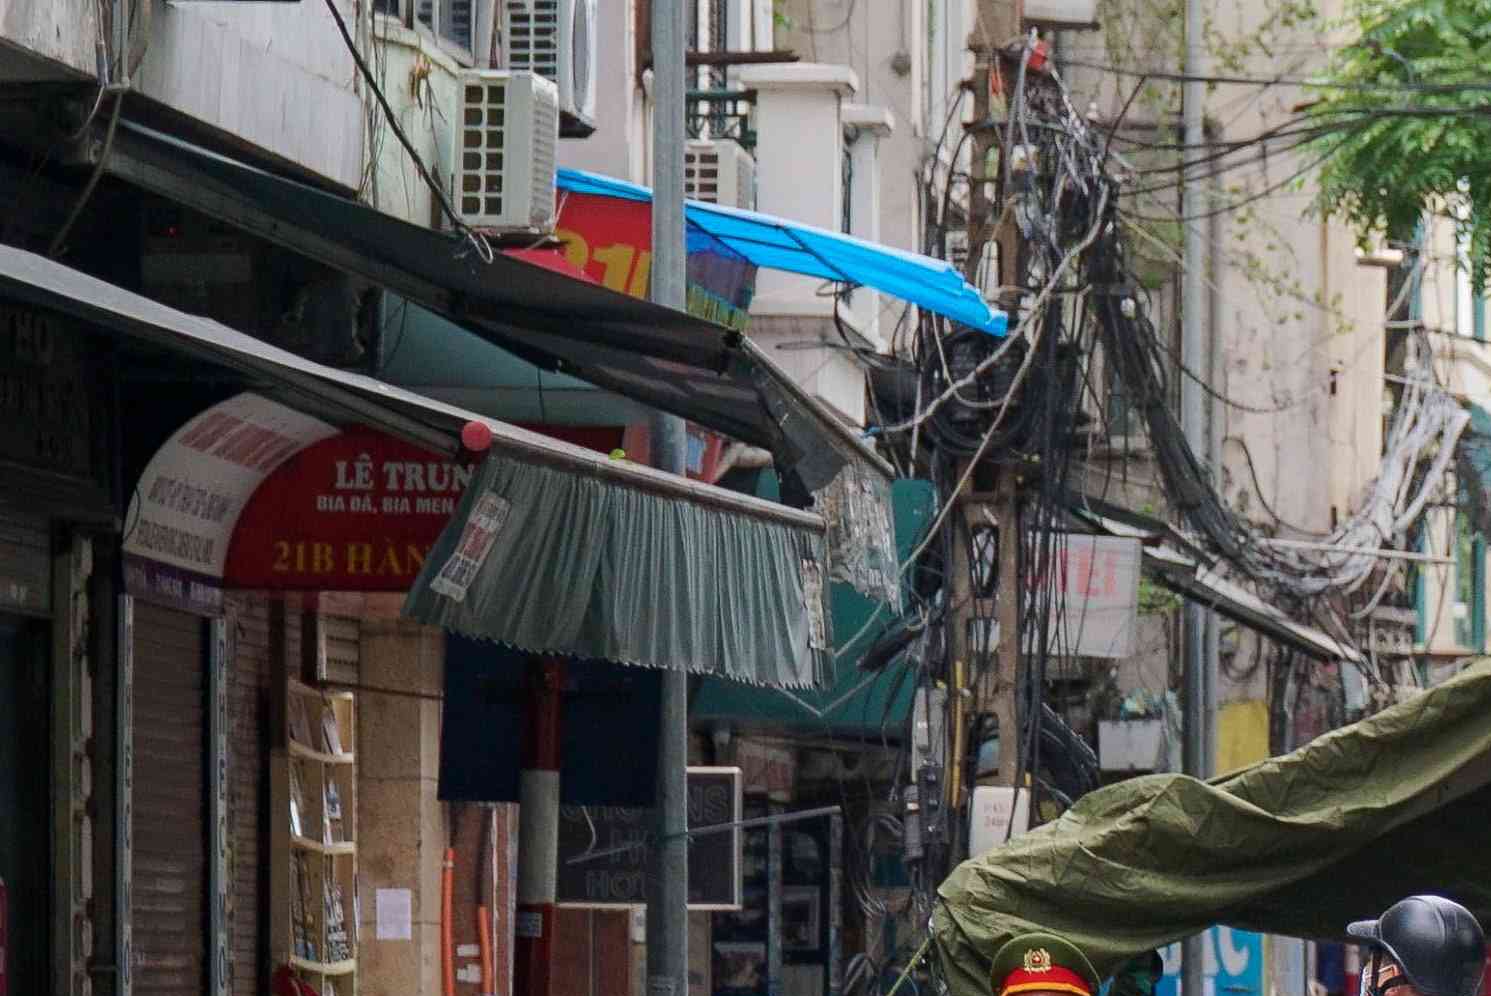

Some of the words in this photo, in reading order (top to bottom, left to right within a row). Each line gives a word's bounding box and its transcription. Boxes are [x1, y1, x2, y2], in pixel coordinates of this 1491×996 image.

[335, 453, 375, 491] LÊ
[384, 461, 476, 492] TRUN
[316, 495, 345, 511] BIA
[382, 496, 410, 512] BIA
[415, 497, 453, 513] MEN
[271, 541, 334, 573] 21B
[346, 535, 428, 575] HÀN
